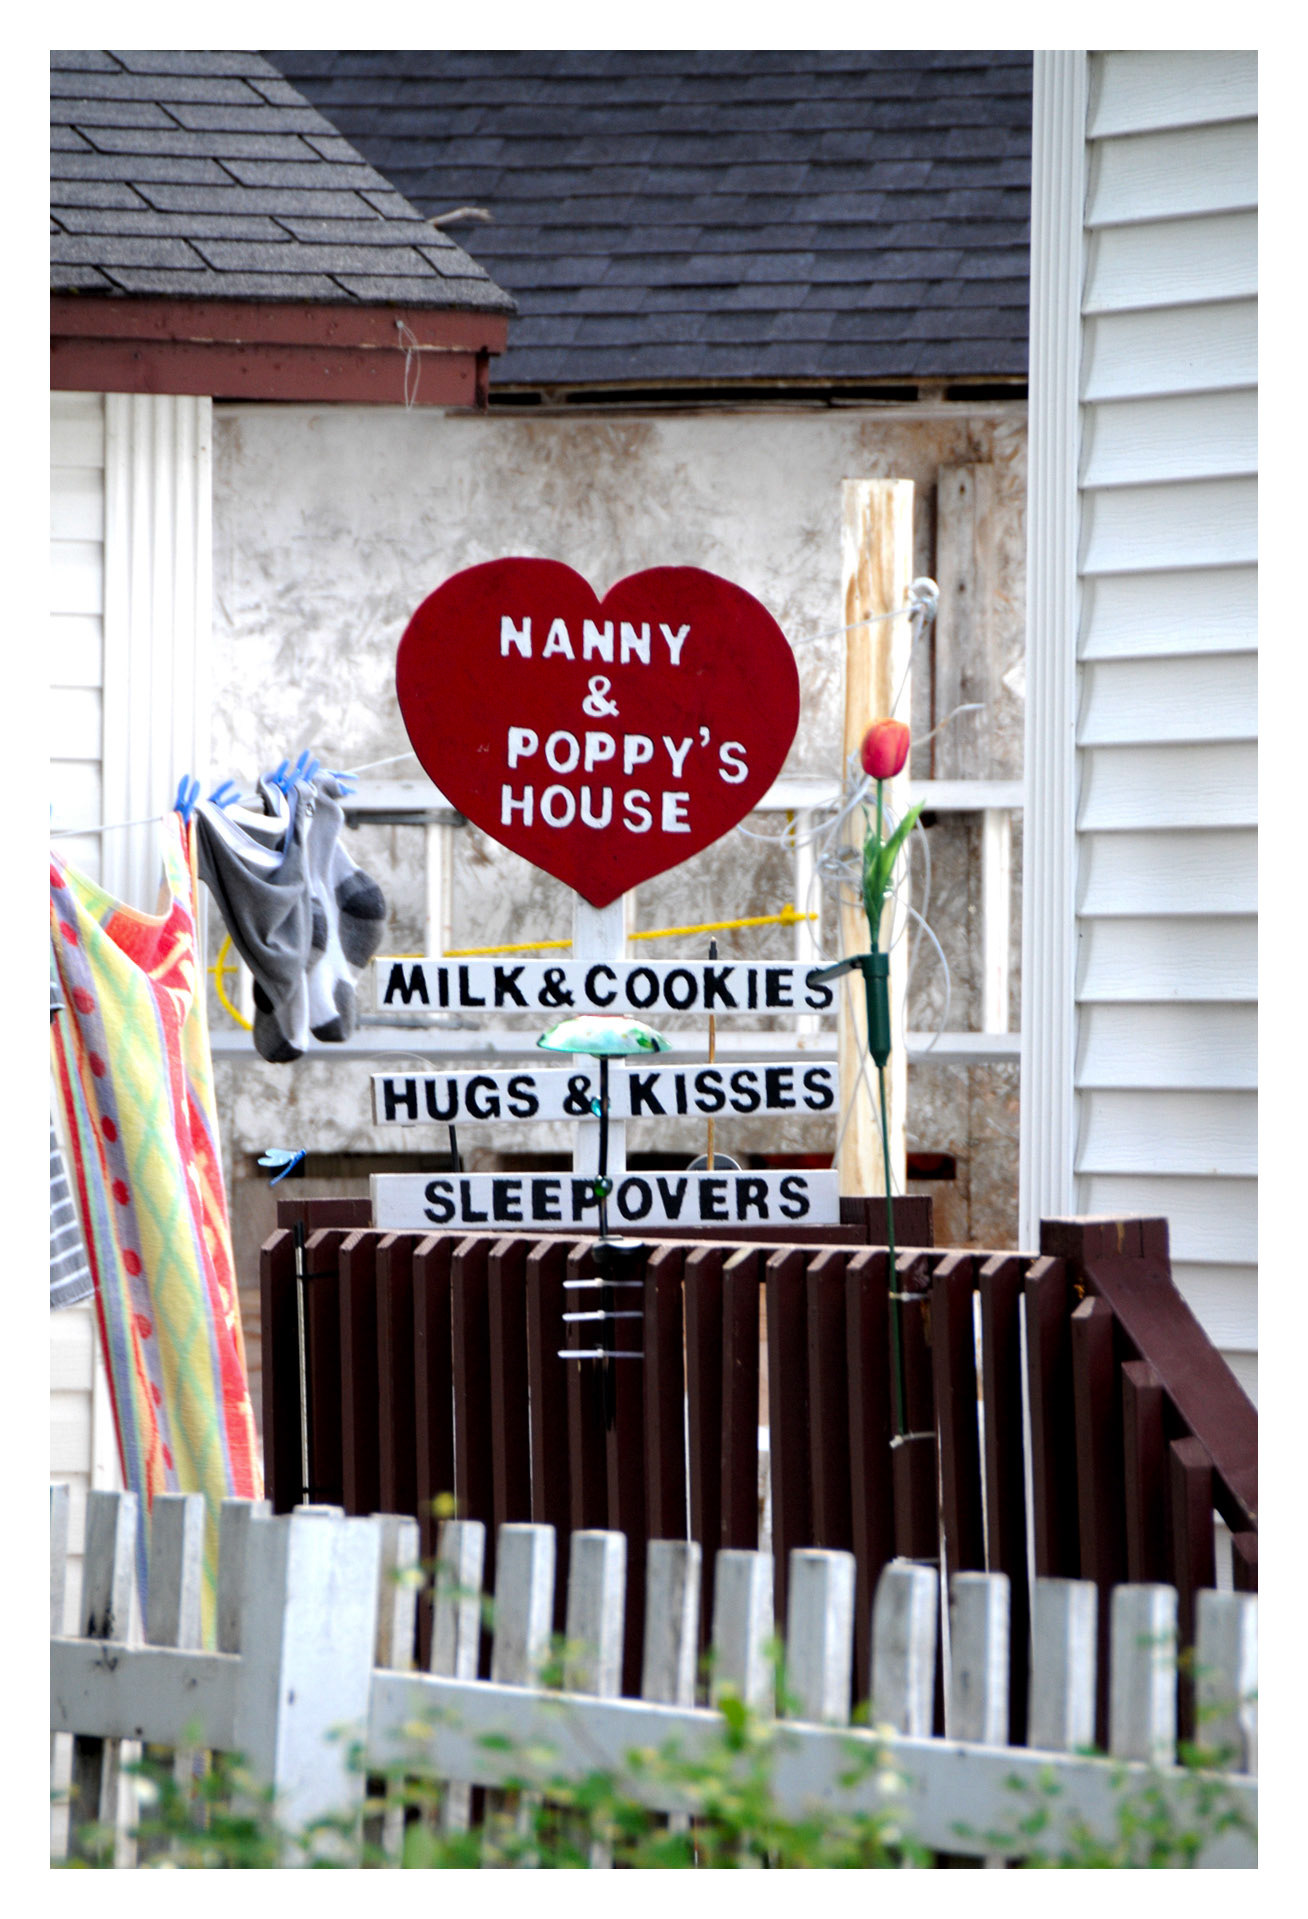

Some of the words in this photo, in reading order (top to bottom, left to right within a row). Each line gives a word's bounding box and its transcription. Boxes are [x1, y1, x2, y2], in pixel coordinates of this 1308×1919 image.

[501, 615, 691, 666] NANNY
[582, 675, 620, 718] &
[500, 784, 692, 833] HOUSE
[383, 1074, 540, 1121] HUGS
[562, 1074, 600, 1117] &
[629, 1067, 835, 1117] KISSES
